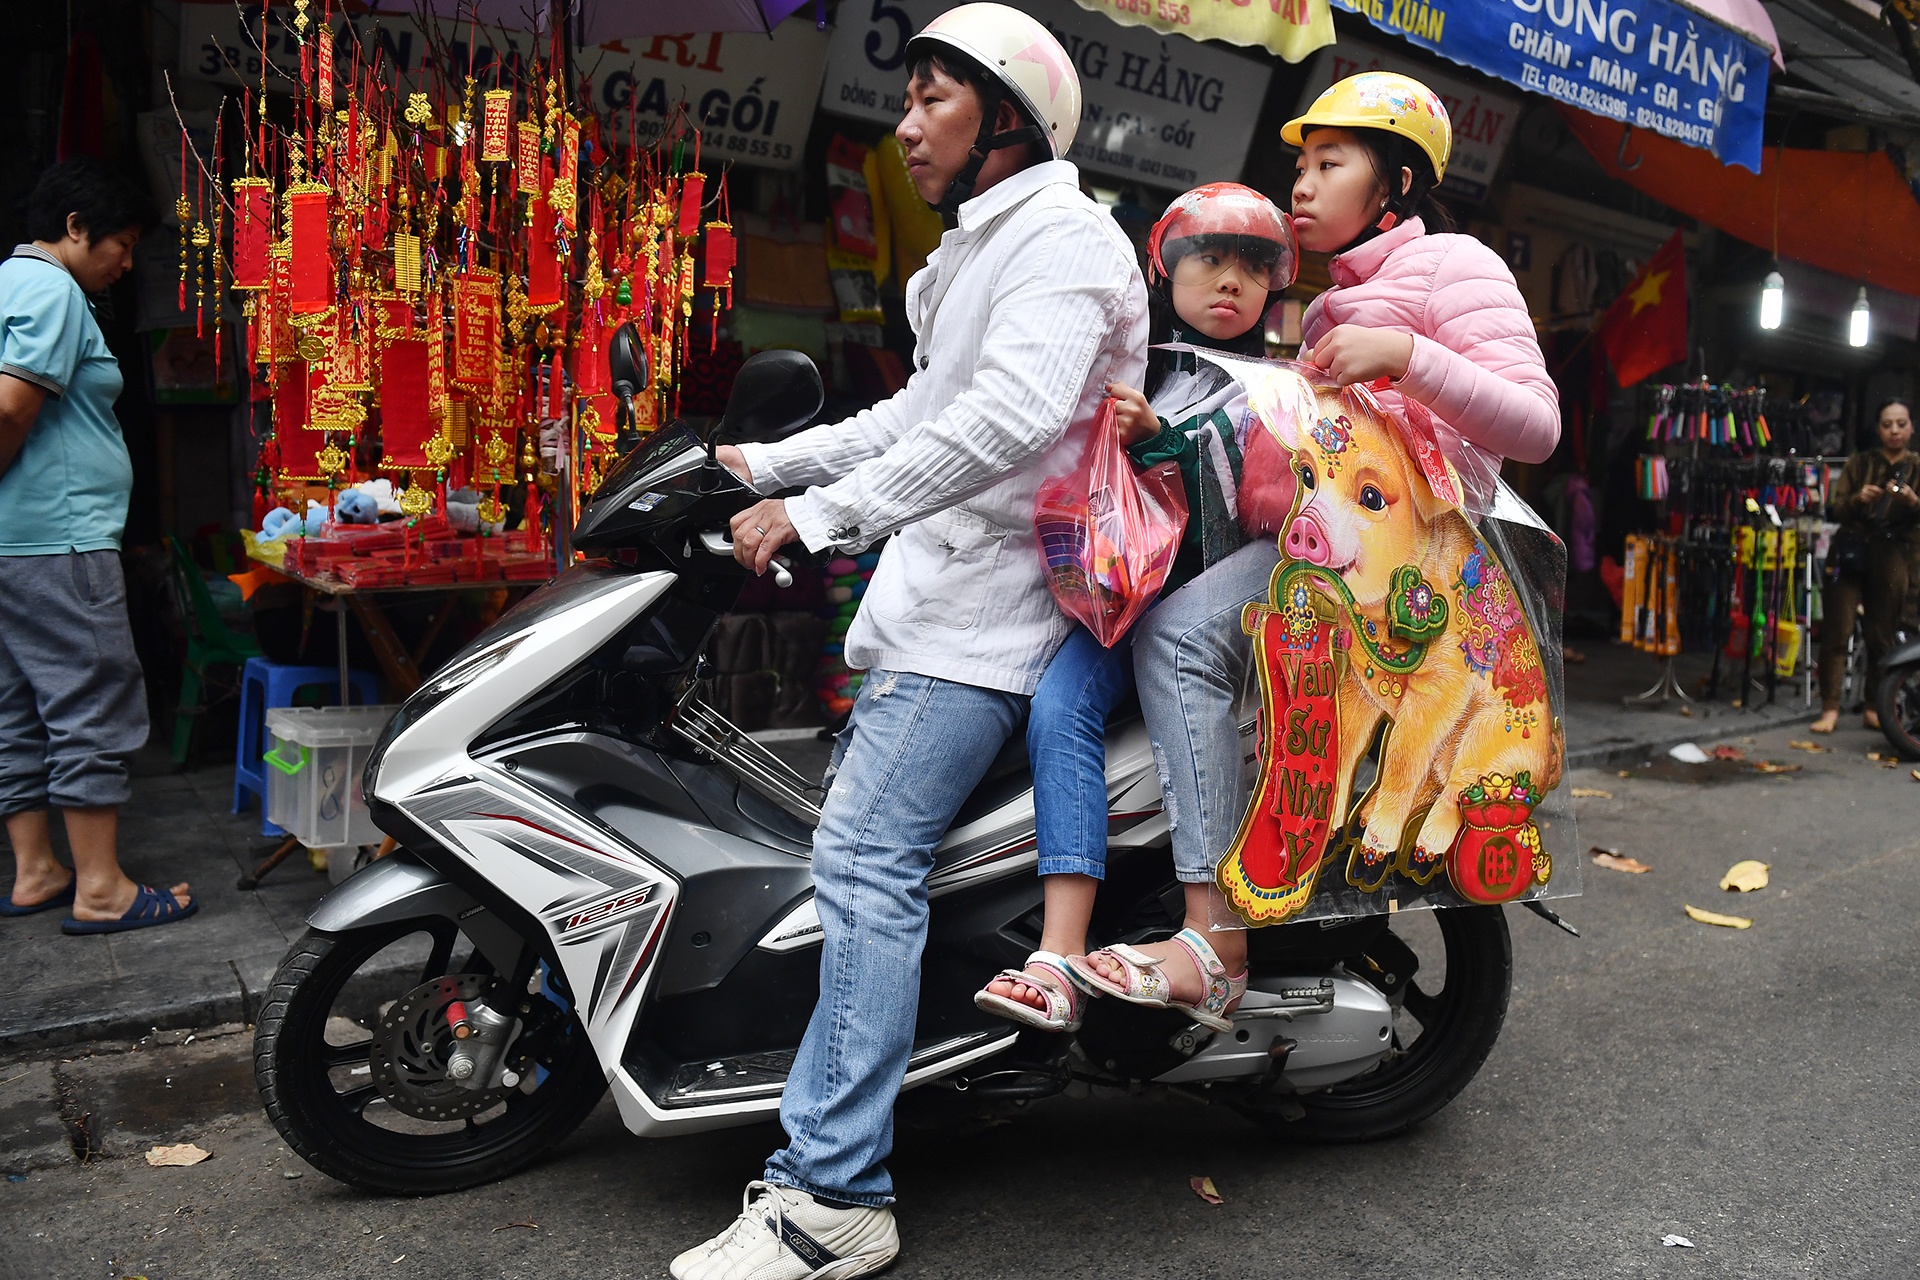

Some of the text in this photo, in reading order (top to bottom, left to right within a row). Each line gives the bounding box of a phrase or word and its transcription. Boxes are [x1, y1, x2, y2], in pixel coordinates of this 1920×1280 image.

[1388, 0, 1446, 43] XUÂN
[1115, 41, 1223, 113] HẰNG
[1509, 22, 1571, 69] CHĂN
[1589, 56, 1637, 95] MÀN
[1654, 82, 1679, 112] GA
[1521, 62, 1546, 90] TEL:
[1648, 20, 1746, 103] HẰNG
[603, 71, 779, 135] GA GỐI
[772, 143, 792, 160] 53
[1161, 119, 1196, 149] GỐI
[480, 394, 515, 404] VN
[1285, 828, 1314, 884] Ý
[1485, 845, 1513, 886] 旺
[564, 886, 653, 932] 125
[1292, 1031, 1360, 1043] HONDA
